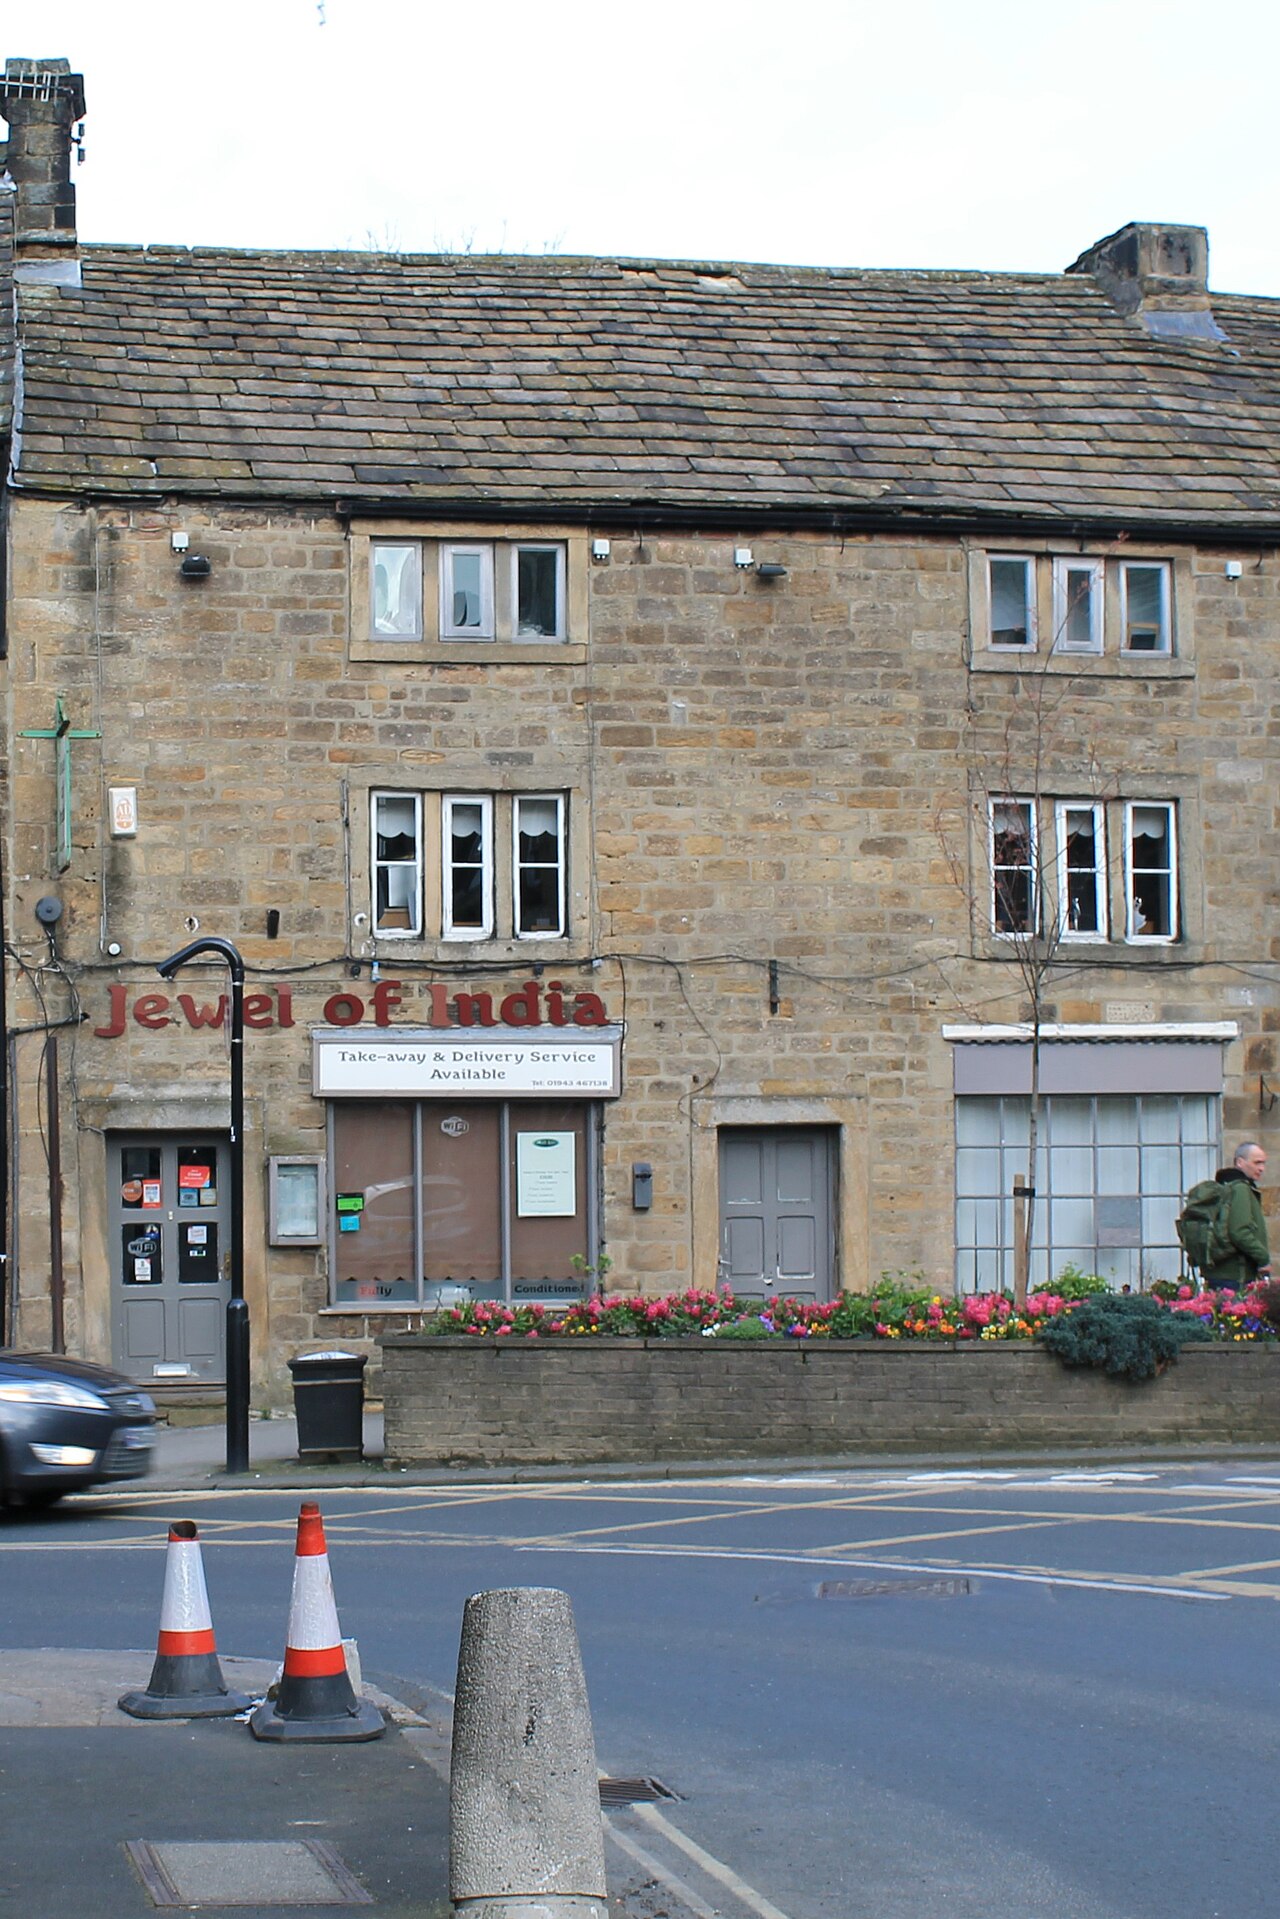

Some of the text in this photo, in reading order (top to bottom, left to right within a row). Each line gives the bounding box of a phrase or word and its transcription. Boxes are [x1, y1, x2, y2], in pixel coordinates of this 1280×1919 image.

[94, 980, 611, 1039] Jewel of India
[338, 1051, 597, 1065] Take-away & Delivery Service
[430, 1068, 507, 1080] Available
[359, 1286, 392, 1297] Fully
